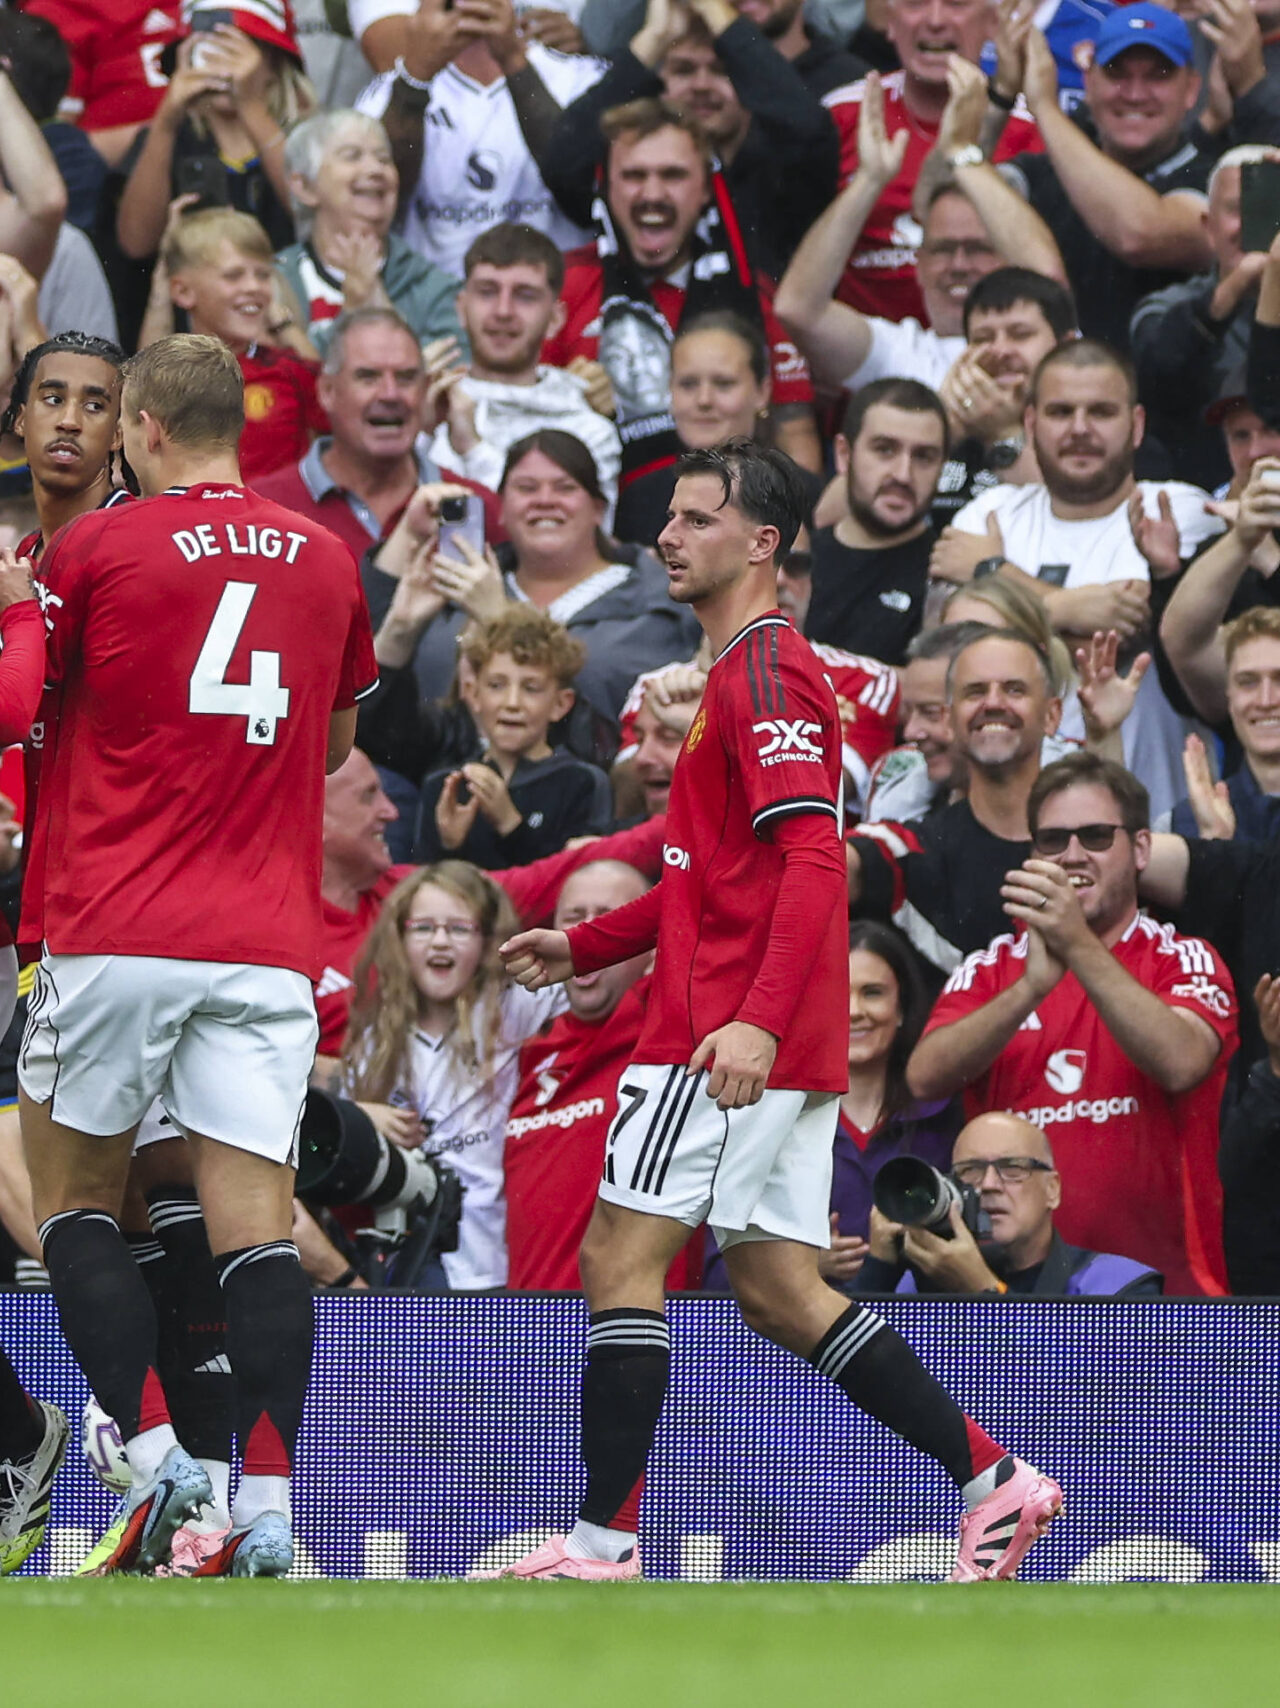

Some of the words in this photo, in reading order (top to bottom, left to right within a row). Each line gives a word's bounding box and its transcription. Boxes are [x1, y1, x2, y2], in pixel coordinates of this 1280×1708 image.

[171, 523, 222, 563] DE
[225, 523, 308, 564] LIGT
[189, 580, 290, 745] 4
[751, 719, 824, 757] DXC
[760, 752, 823, 768] TECHNOLO
[609, 1084, 649, 1146] 7
[1006, 1096, 1139, 1130] napdragon
